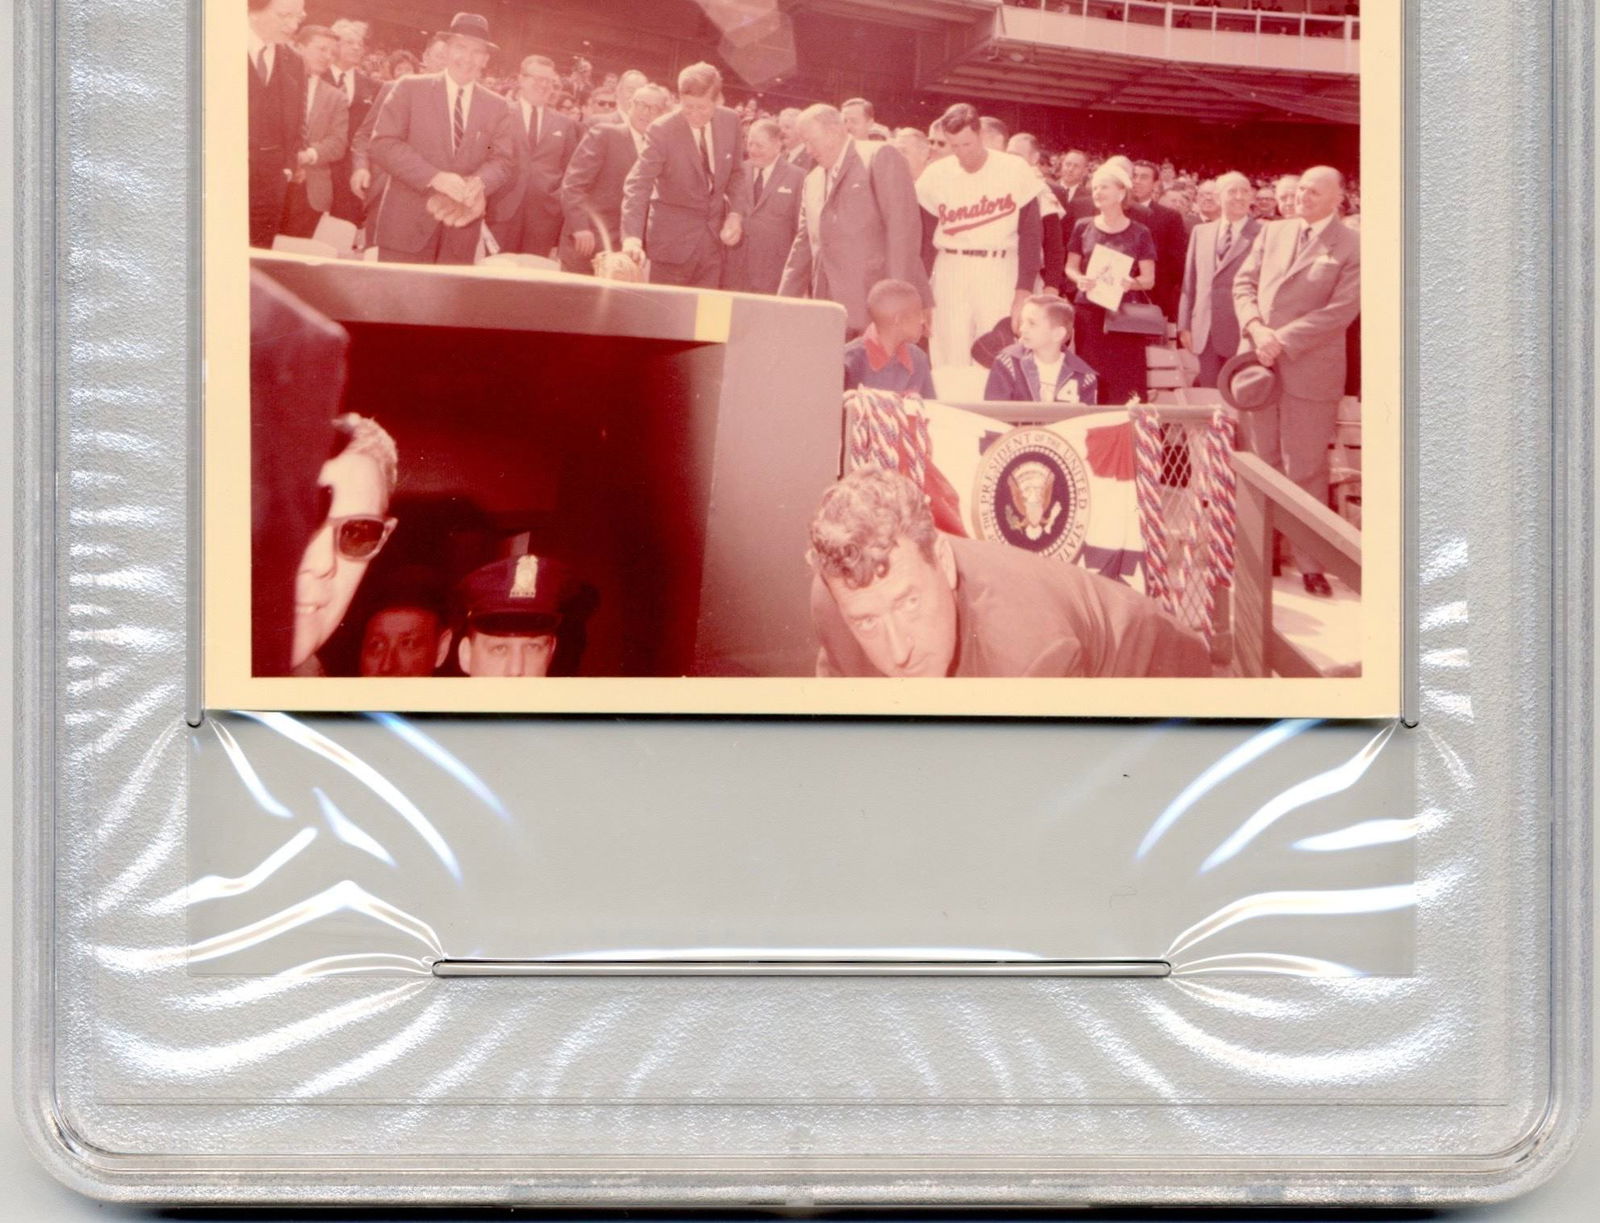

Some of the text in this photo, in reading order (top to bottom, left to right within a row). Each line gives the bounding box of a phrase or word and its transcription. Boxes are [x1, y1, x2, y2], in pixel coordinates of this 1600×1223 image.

[939, 192, 1016, 226] Senators
[981, 433, 1029, 505] PRESIDENT
[1064, 448, 1088, 510] UNITED
